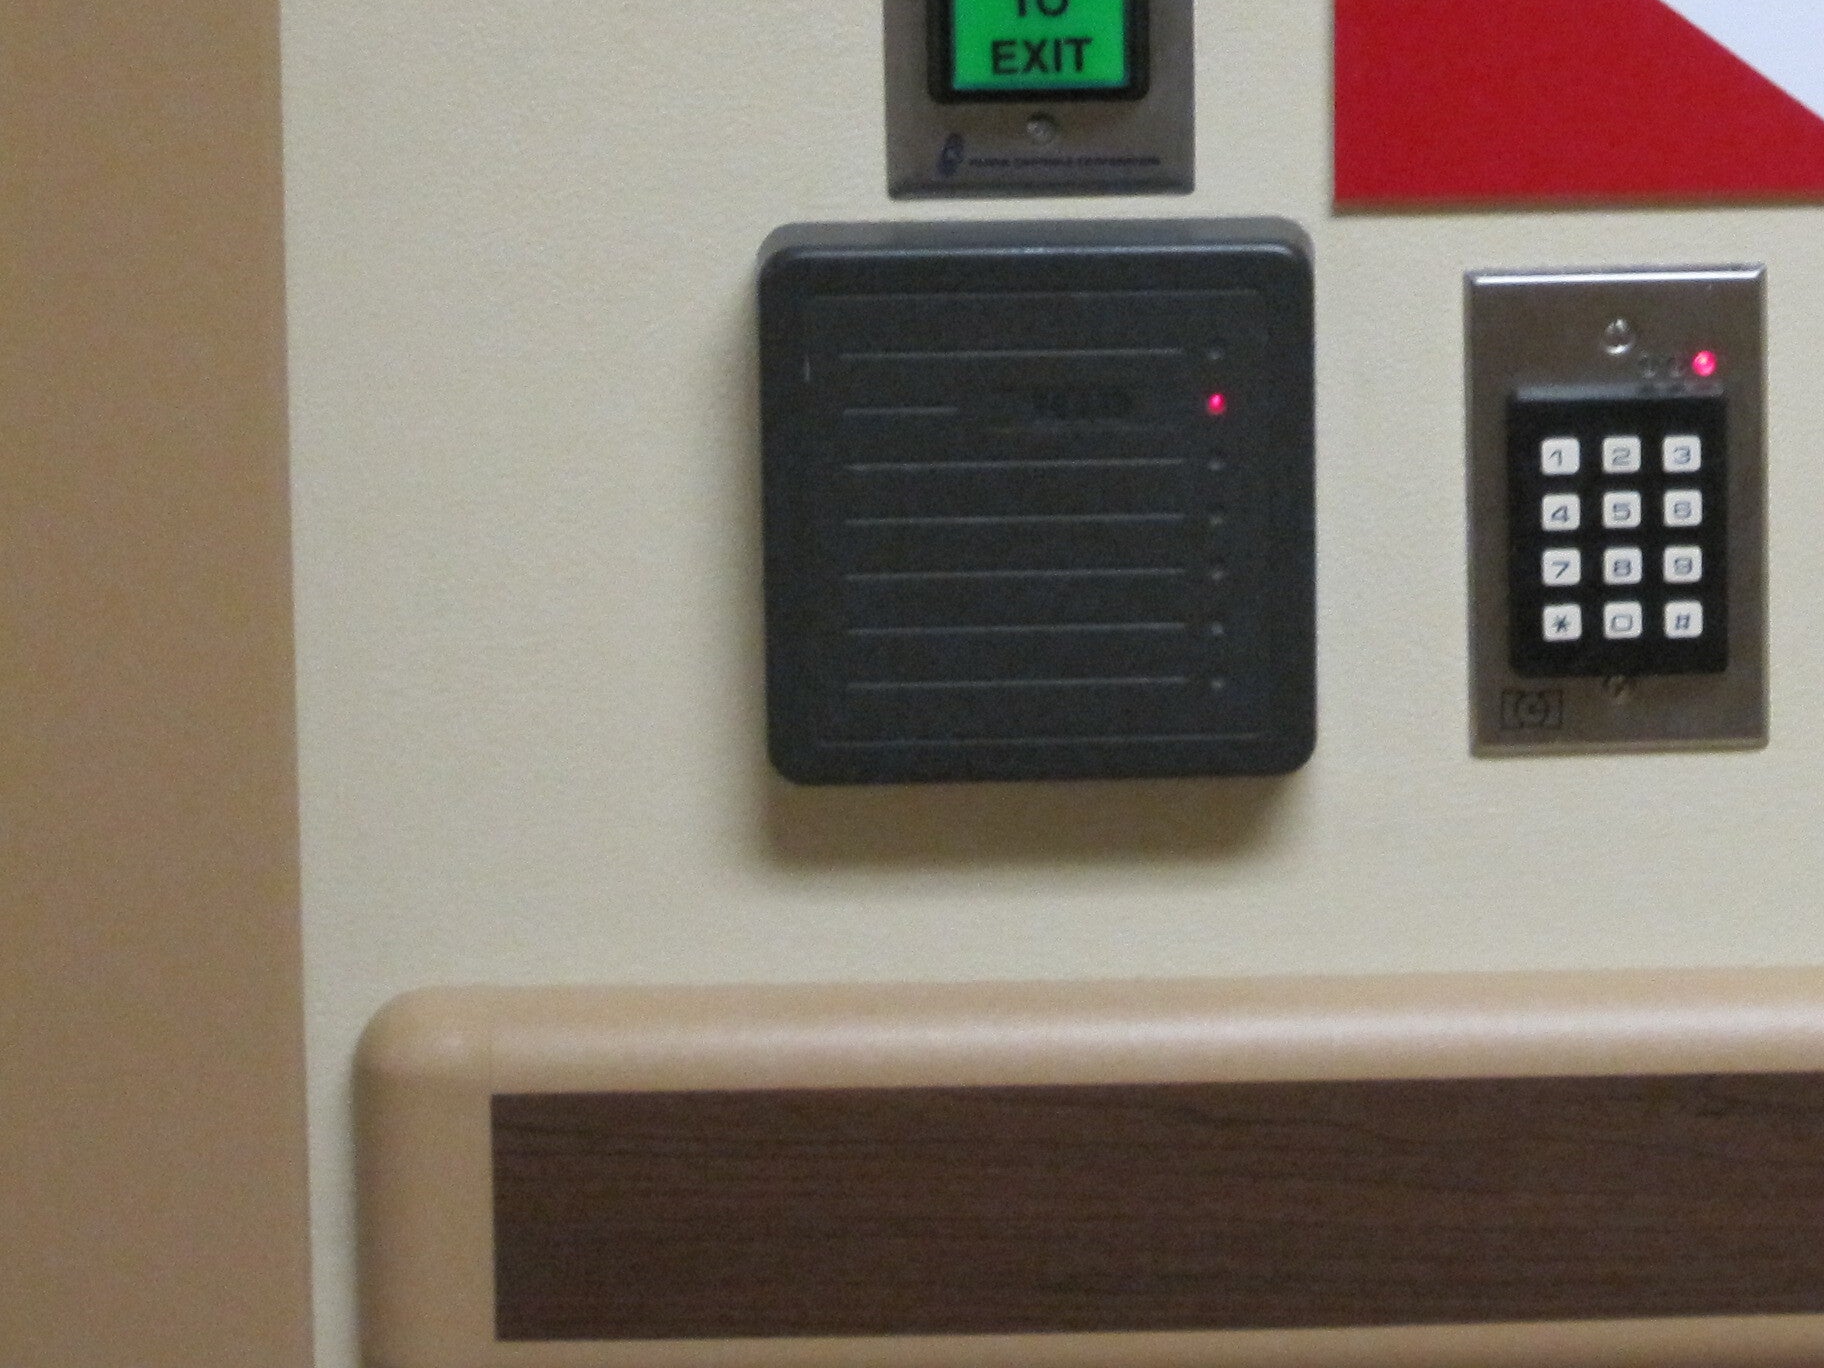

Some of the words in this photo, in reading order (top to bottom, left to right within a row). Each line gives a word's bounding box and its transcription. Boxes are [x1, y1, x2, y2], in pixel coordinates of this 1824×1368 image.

[991, 36, 1094, 77] EXIT
[1550, 448, 1564, 468] 1
[1611, 447, 1632, 467] 2
[1673, 445, 1692, 466] 3
[1550, 504, 1571, 524] 4
[1611, 502, 1632, 523] 5
[1672, 500, 1693, 520] 6
[1551, 559, 1571, 580] 7
[1612, 558, 1633, 578] 8
[1672, 556, 1694, 576] 9
